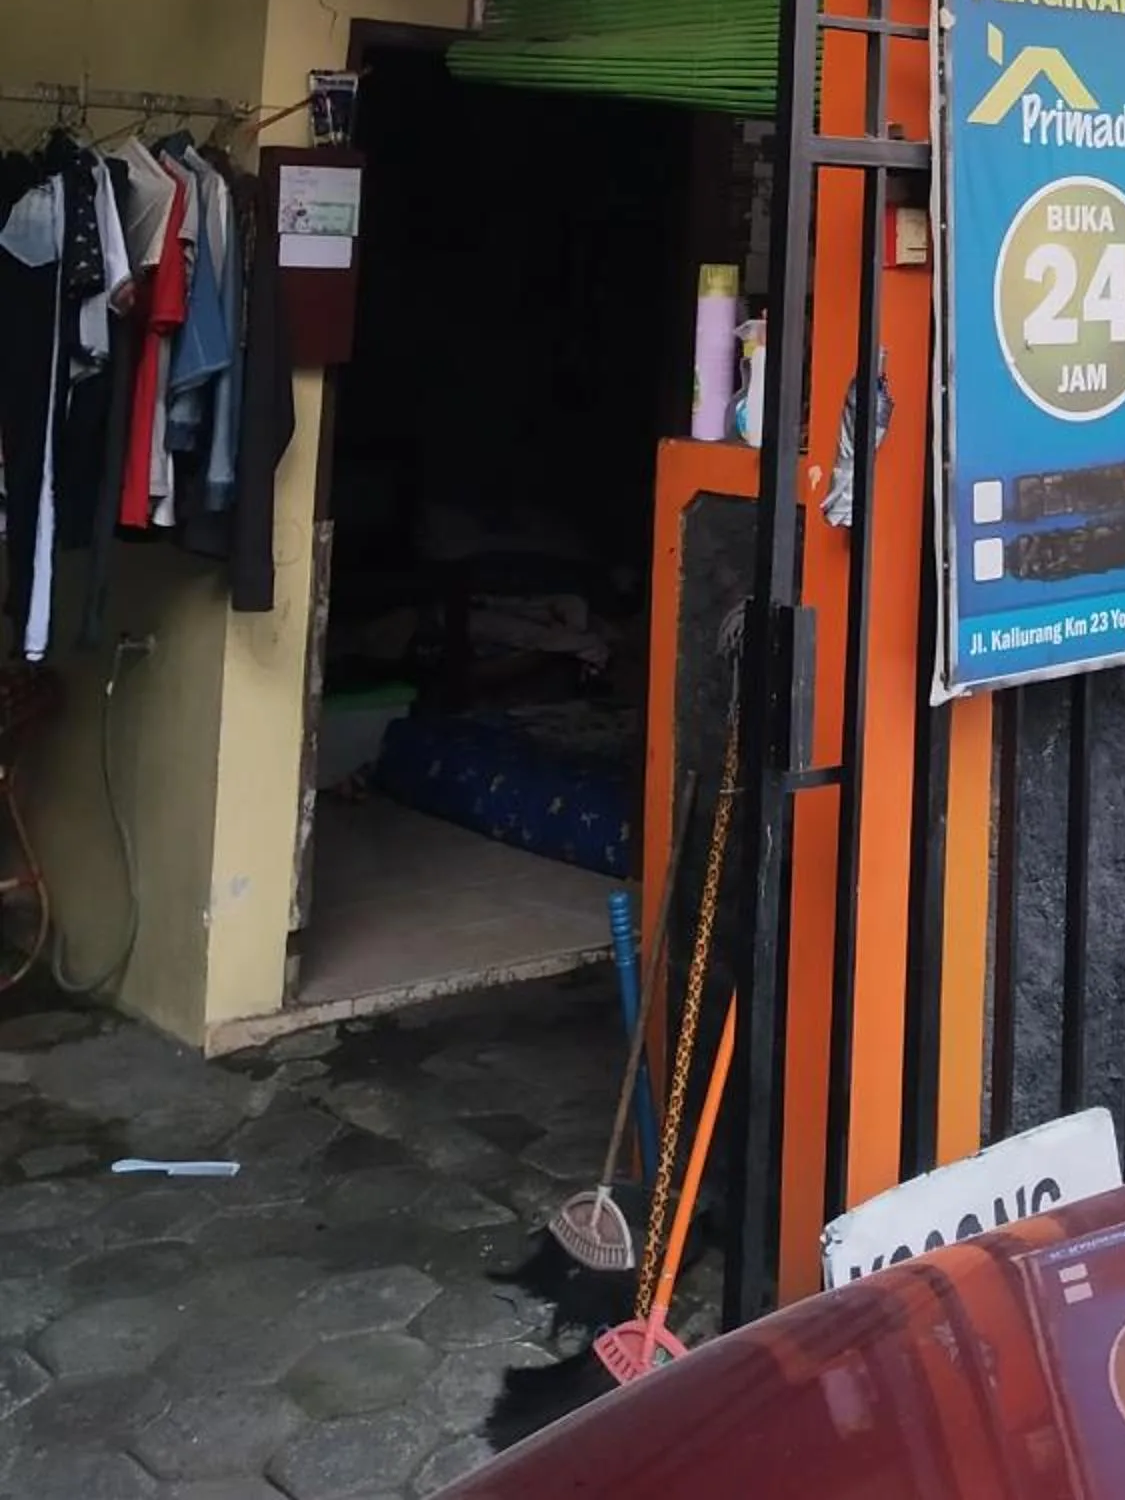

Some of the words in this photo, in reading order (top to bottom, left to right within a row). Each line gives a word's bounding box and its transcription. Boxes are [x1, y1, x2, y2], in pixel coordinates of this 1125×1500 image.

[1047, 204, 1115, 232] BUKA
[1057, 363, 1107, 393] JAM
[991, 620, 1063, 651] Kaliurang
[1065, 616, 1087, 638] Km
[1089, 612, 1109, 633] 23
